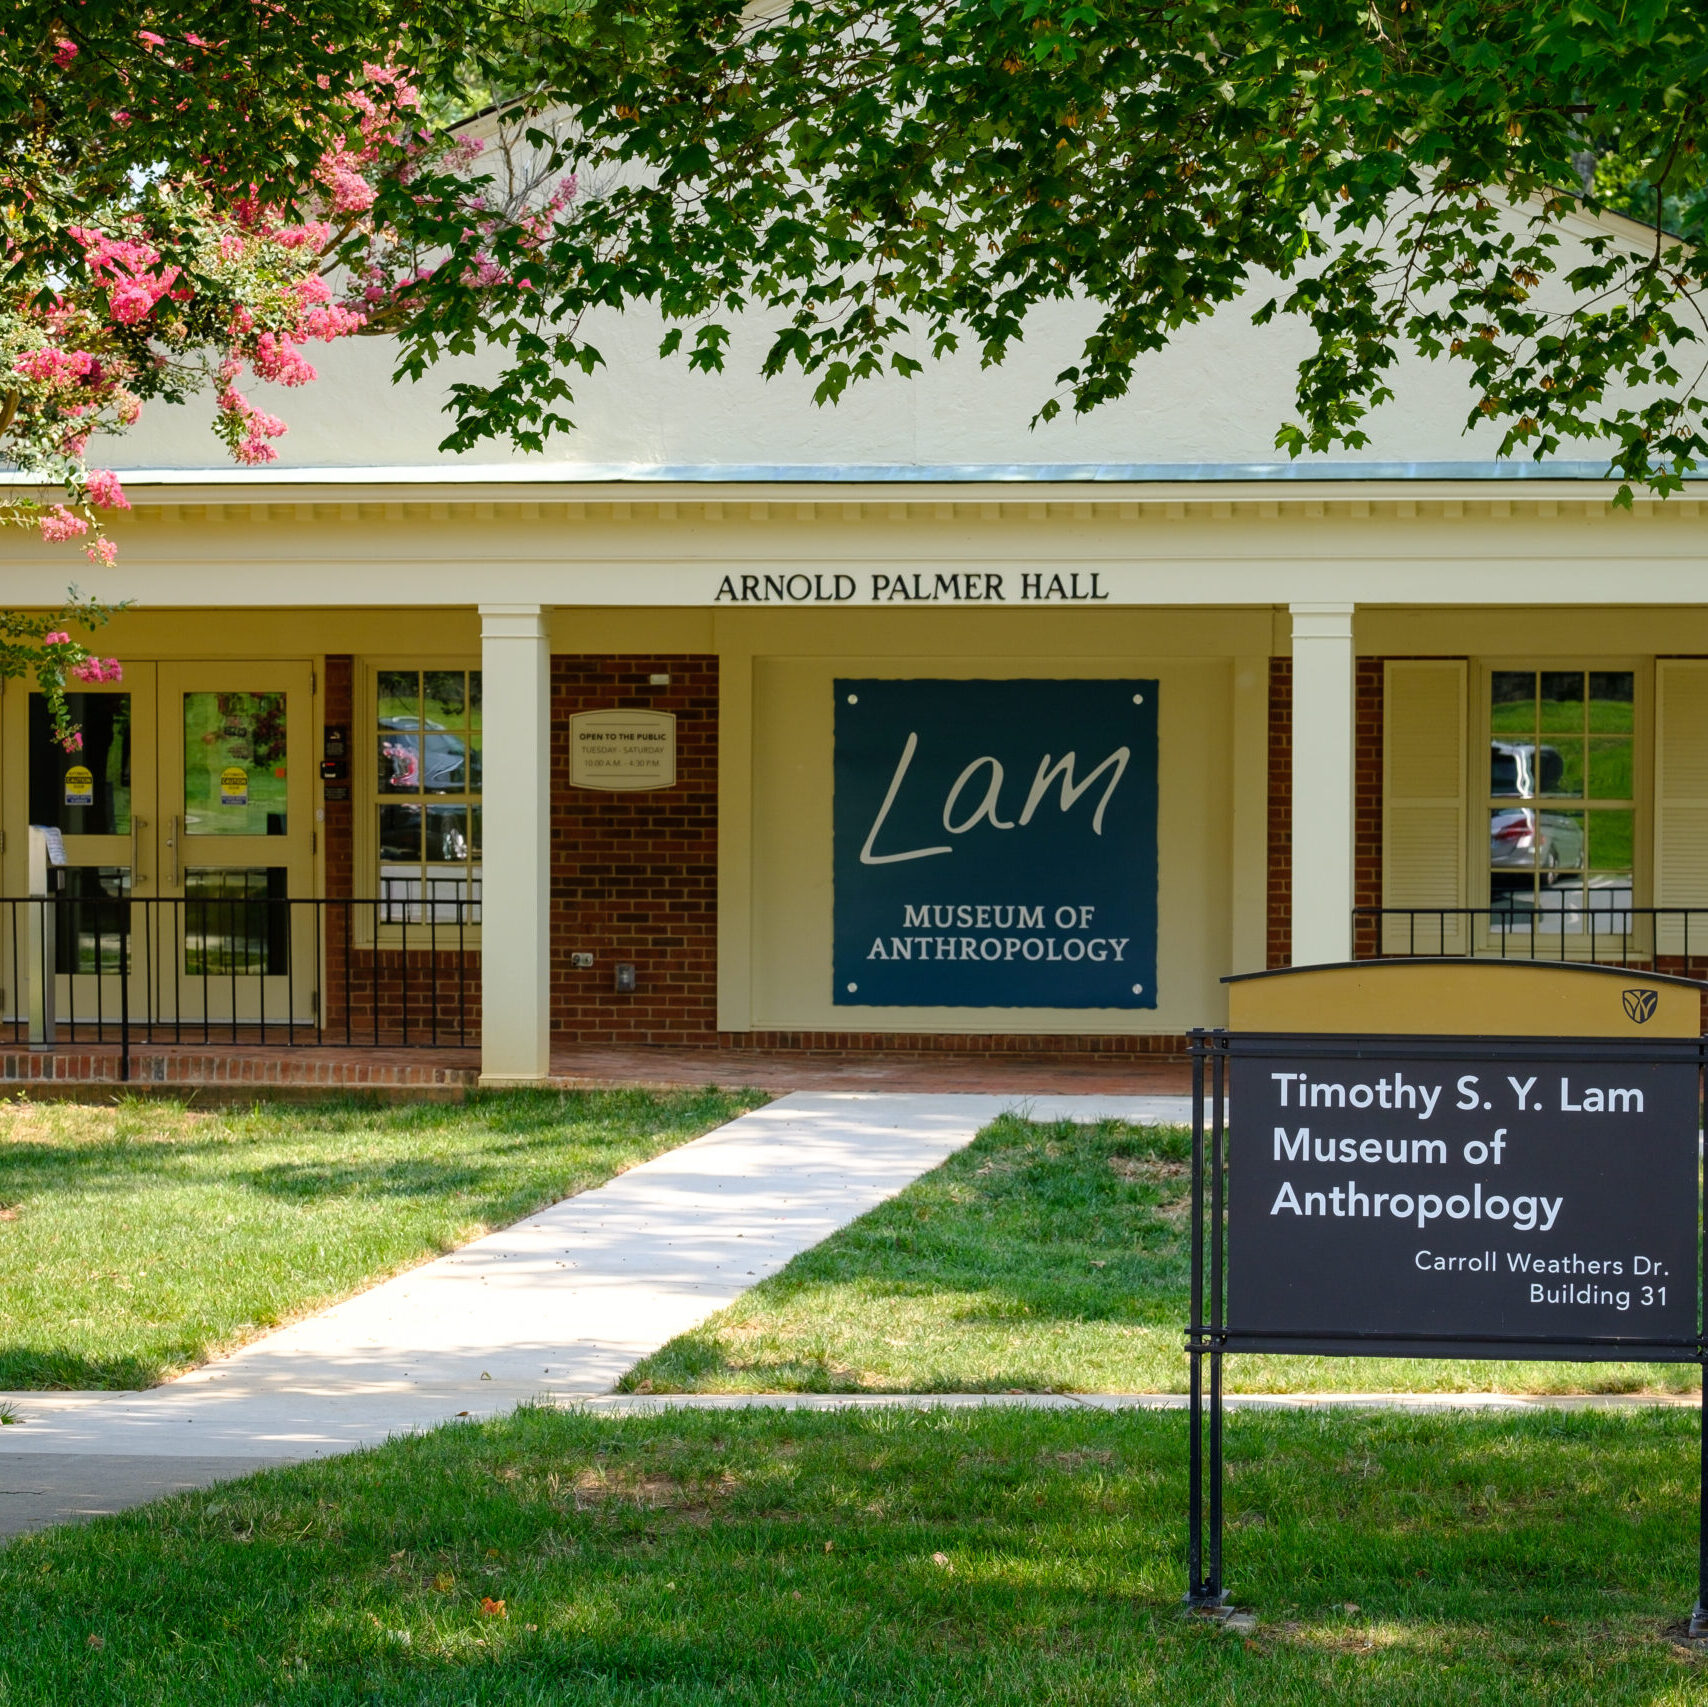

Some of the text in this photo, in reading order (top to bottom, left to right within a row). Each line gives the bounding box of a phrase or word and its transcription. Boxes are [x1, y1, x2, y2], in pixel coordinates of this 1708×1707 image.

[714, 572, 1110, 602] ARNOLD PALMER HALL
[579, 733, 667, 741] OPEN TO THE PUBLIC
[582, 746, 617, 754] TUESDAY
[623, 746, 664, 754] SATURDAY
[859, 731, 1131, 865] Lam
[902, 904, 1095, 929] MUSEUM OF
[866, 937, 1130, 962] ANTHROPOLOGY
[1271, 1072, 1644, 1120] Timothy S. Y. Lam
[1273, 1126, 1508, 1166] Museum of
[1269, 1180, 1564, 1232] Anthropology
[1414, 1249, 1670, 1276] Carroll Weathers Dr.
[1530, 1283, 1667, 1311] Building 31
